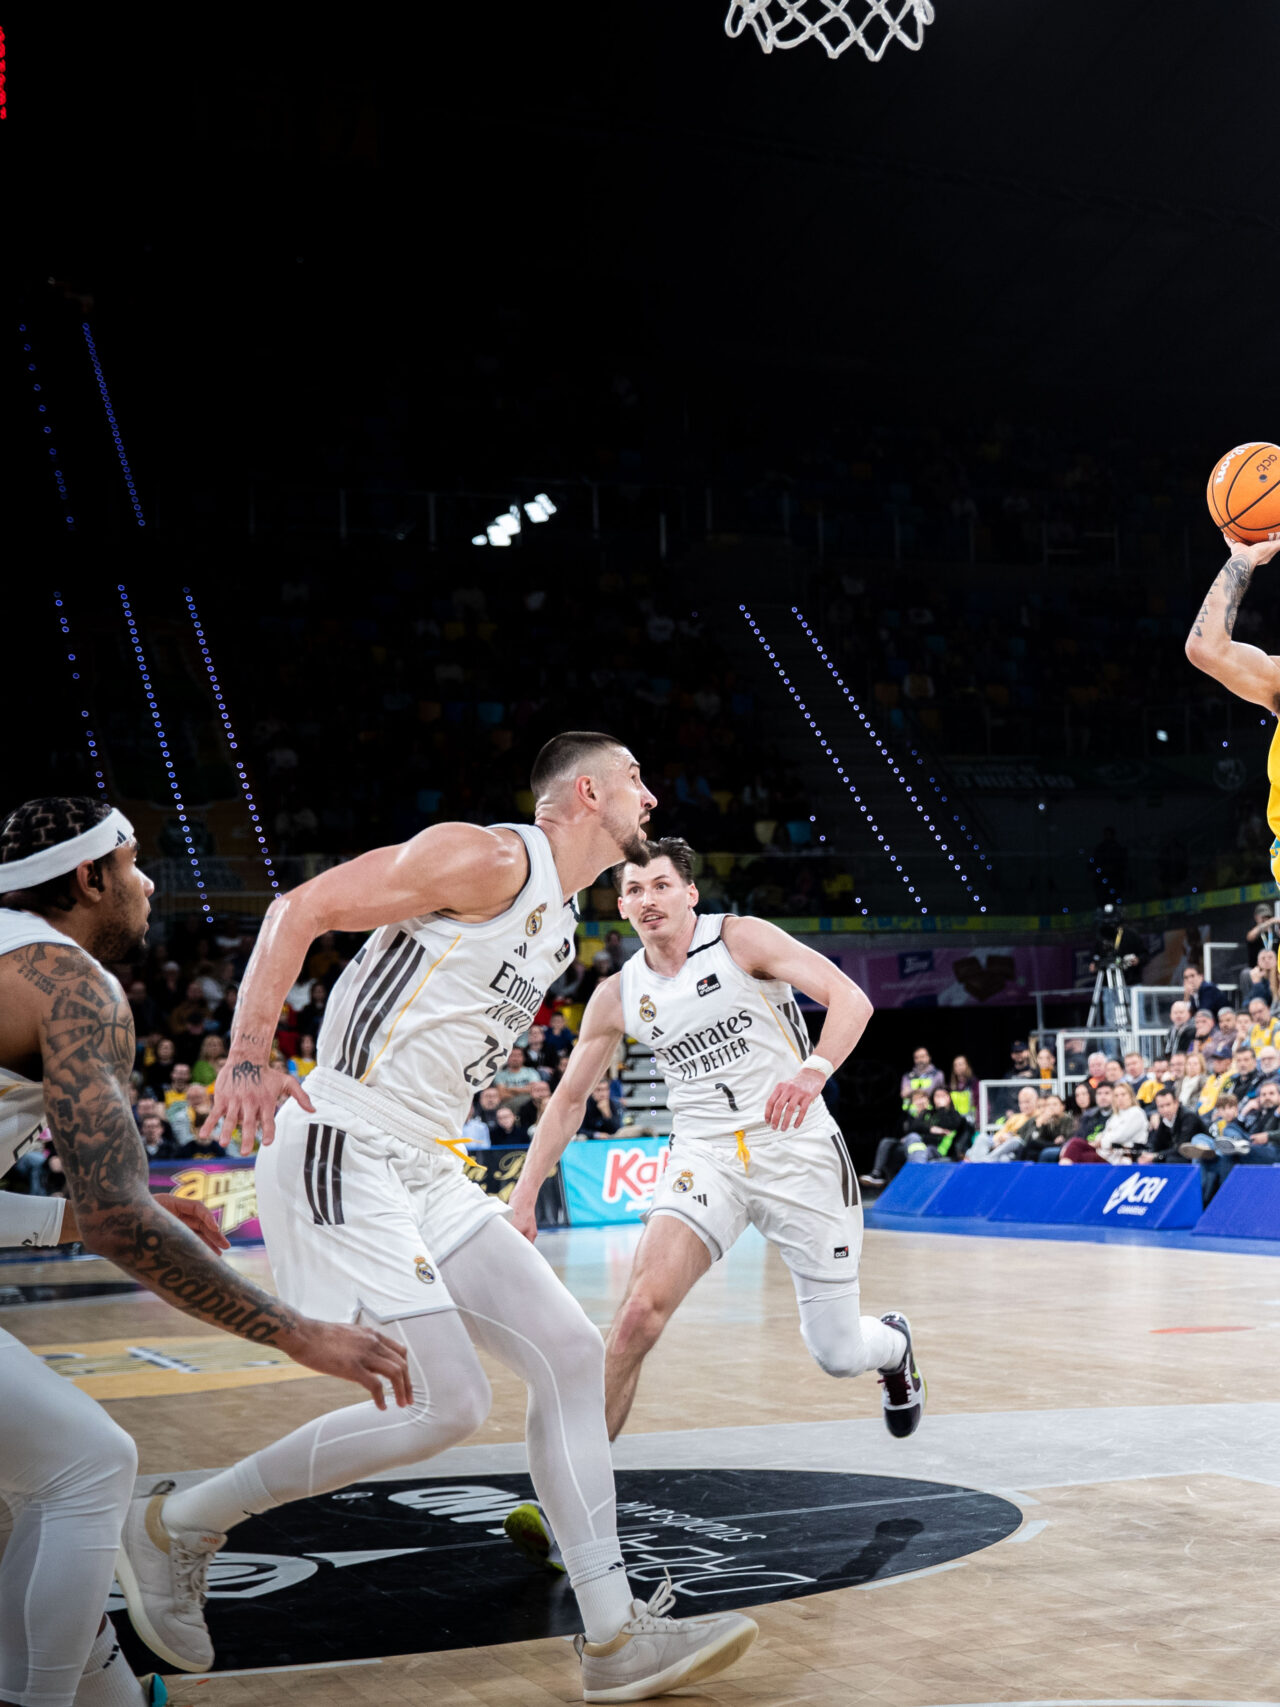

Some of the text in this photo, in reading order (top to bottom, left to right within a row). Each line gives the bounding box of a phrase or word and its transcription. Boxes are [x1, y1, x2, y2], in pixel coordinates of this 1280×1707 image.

[489, 960, 544, 1016] Emira
[464, 1035, 508, 1086] 25
[655, 1010, 752, 1065] Emirates
[700, 1037, 750, 1073] BETTER
